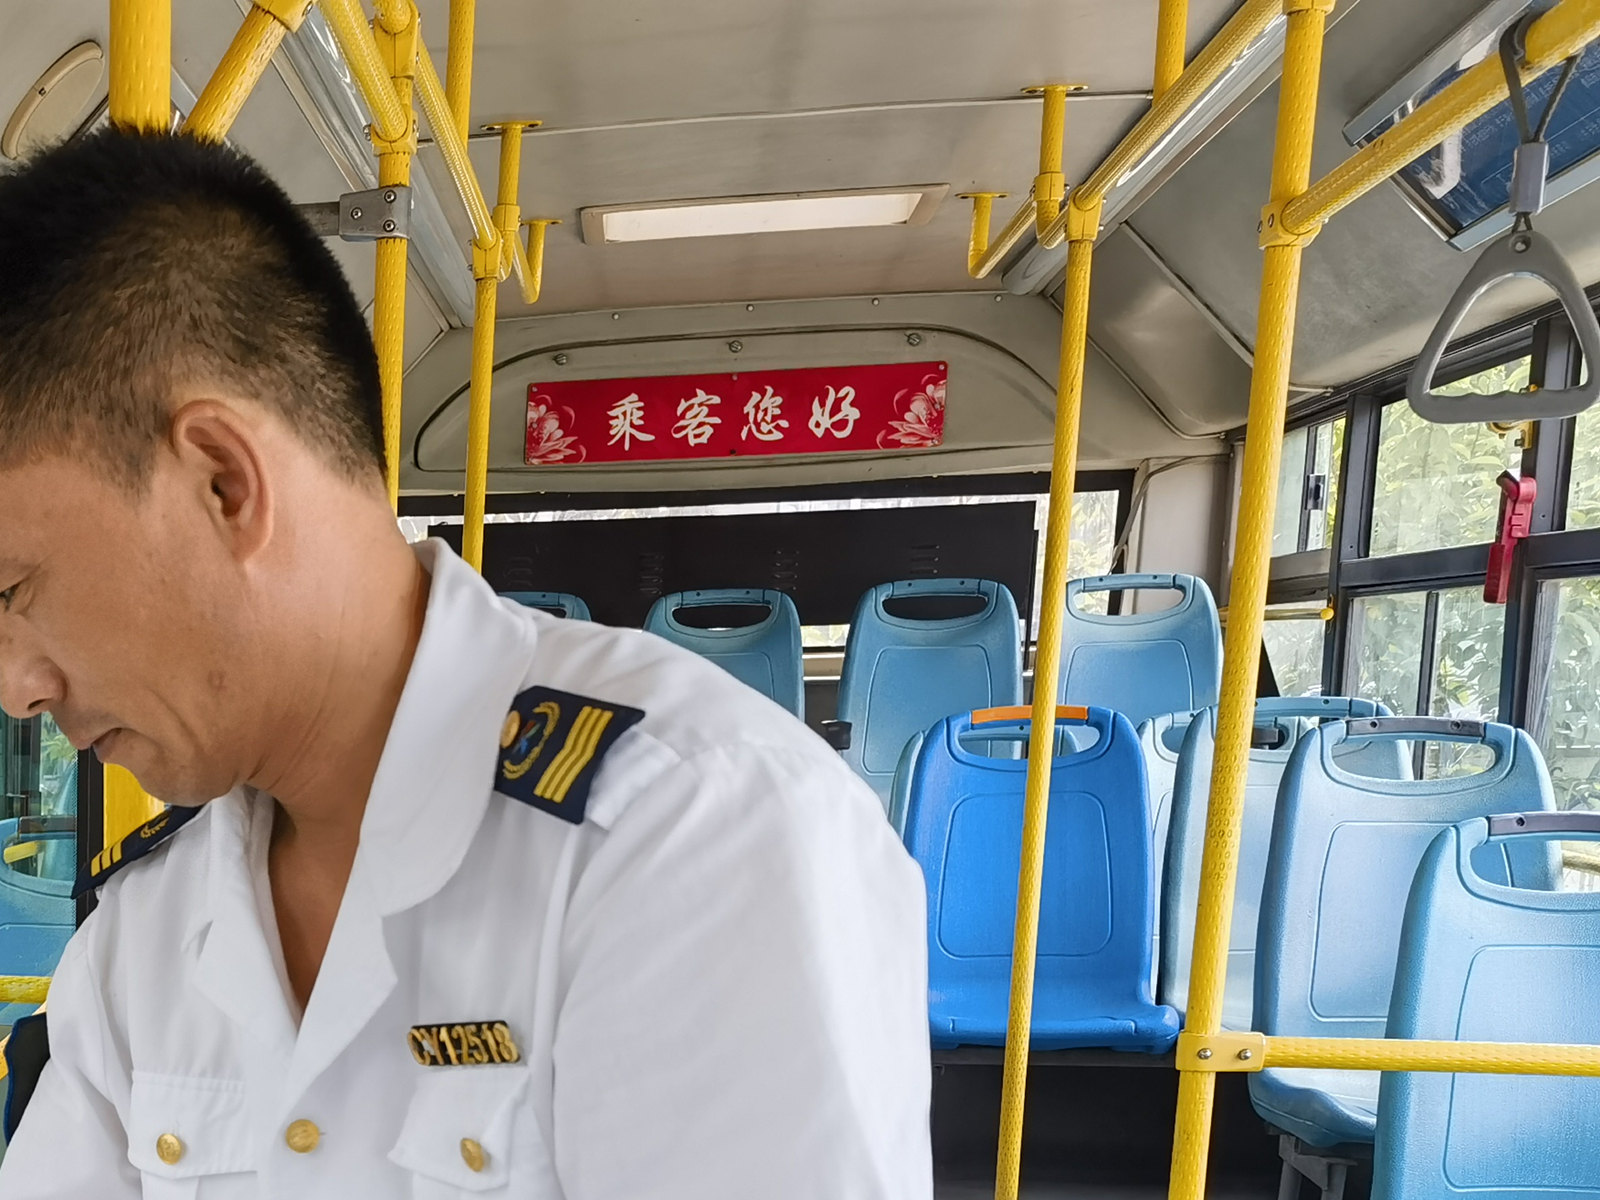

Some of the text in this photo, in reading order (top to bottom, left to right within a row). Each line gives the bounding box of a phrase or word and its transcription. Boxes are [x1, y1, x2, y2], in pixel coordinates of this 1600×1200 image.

[607, 385, 861, 451] 乘客您好
[407, 1023, 518, 1066] CY12518
